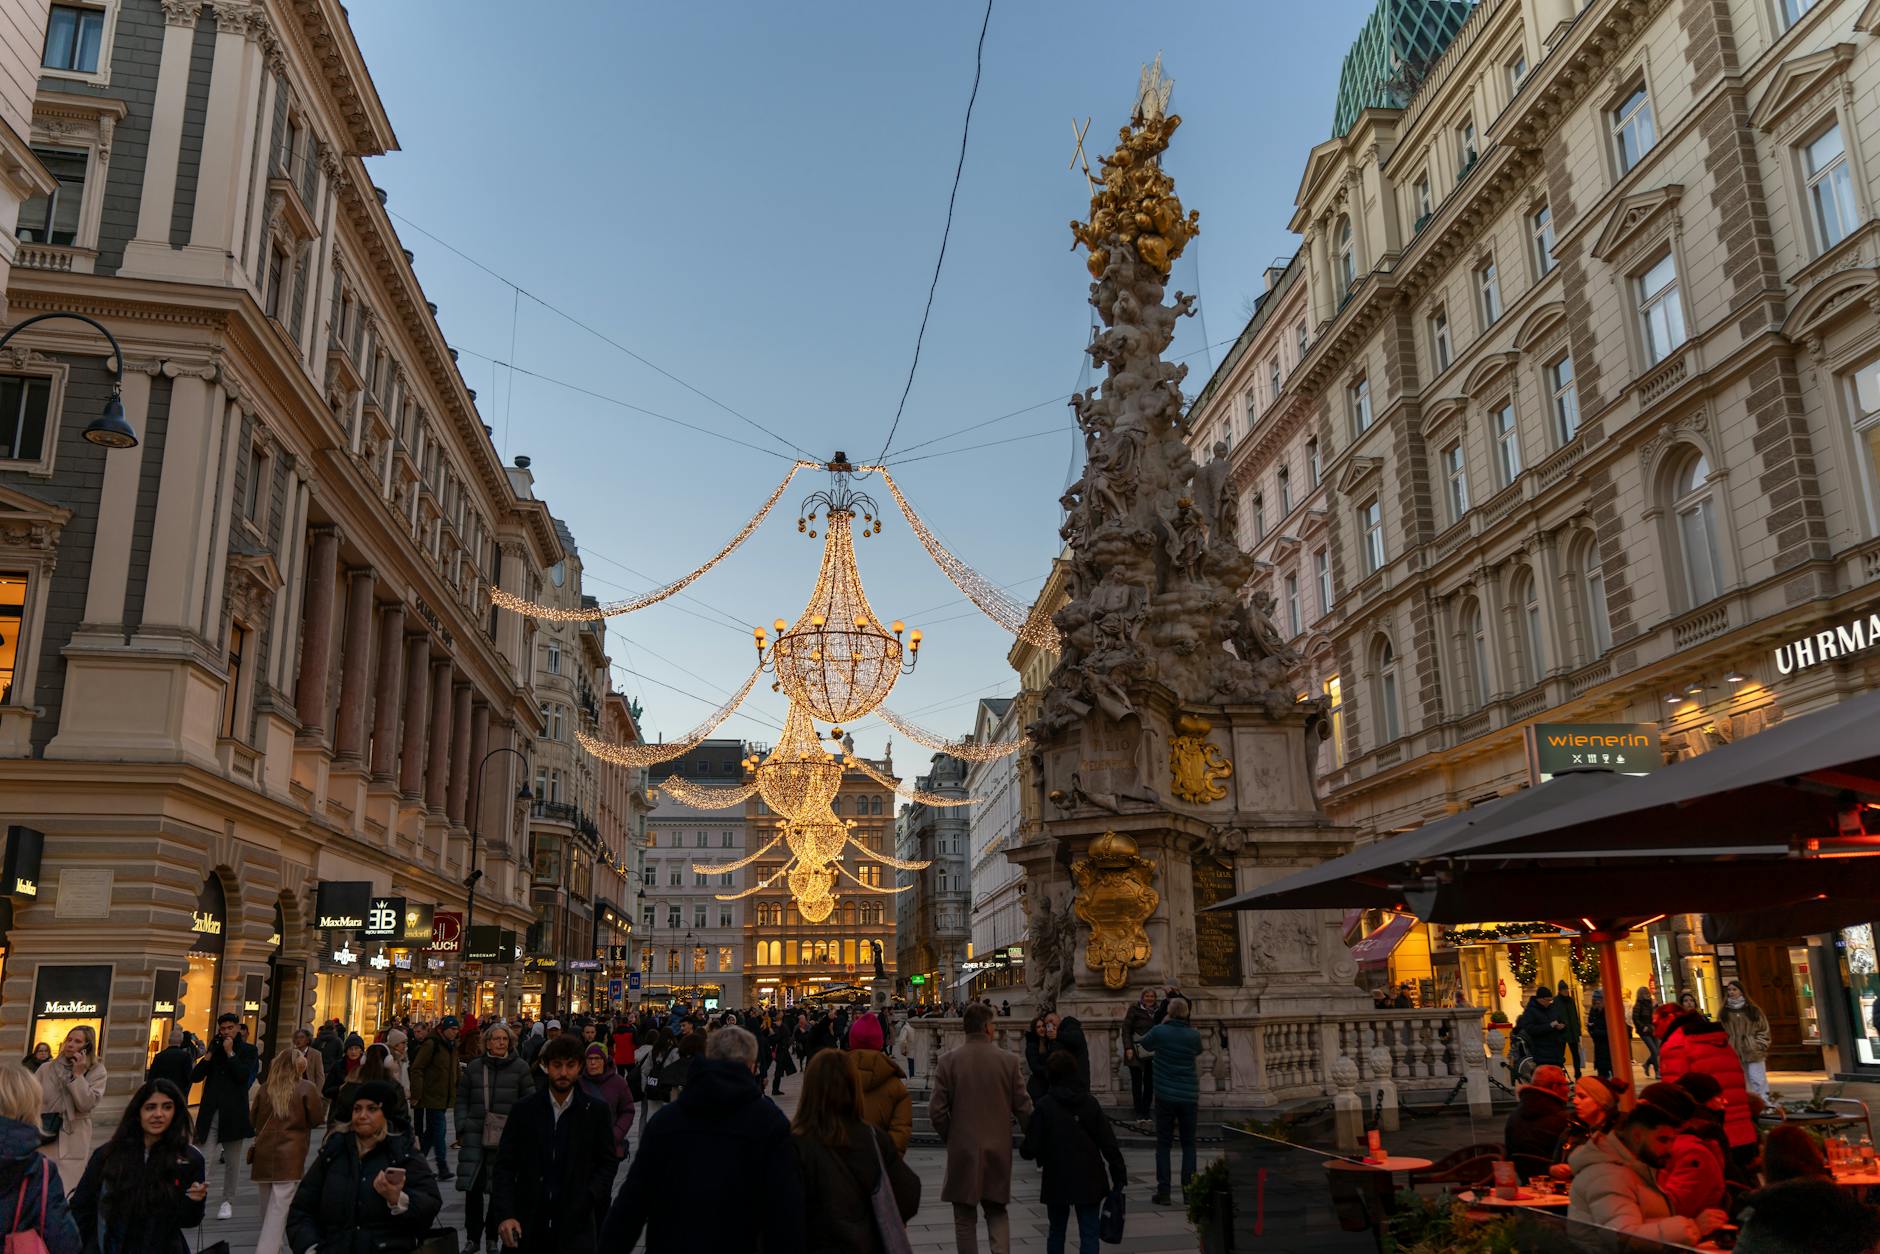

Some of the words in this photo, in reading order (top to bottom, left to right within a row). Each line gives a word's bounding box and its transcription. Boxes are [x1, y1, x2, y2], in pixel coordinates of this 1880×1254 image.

[1547, 733, 1649, 748] wienerin
[320, 916, 363, 927] MaxMara
[430, 941, 459, 951] AUCH
[44, 1001, 97, 1013] MaxMara
